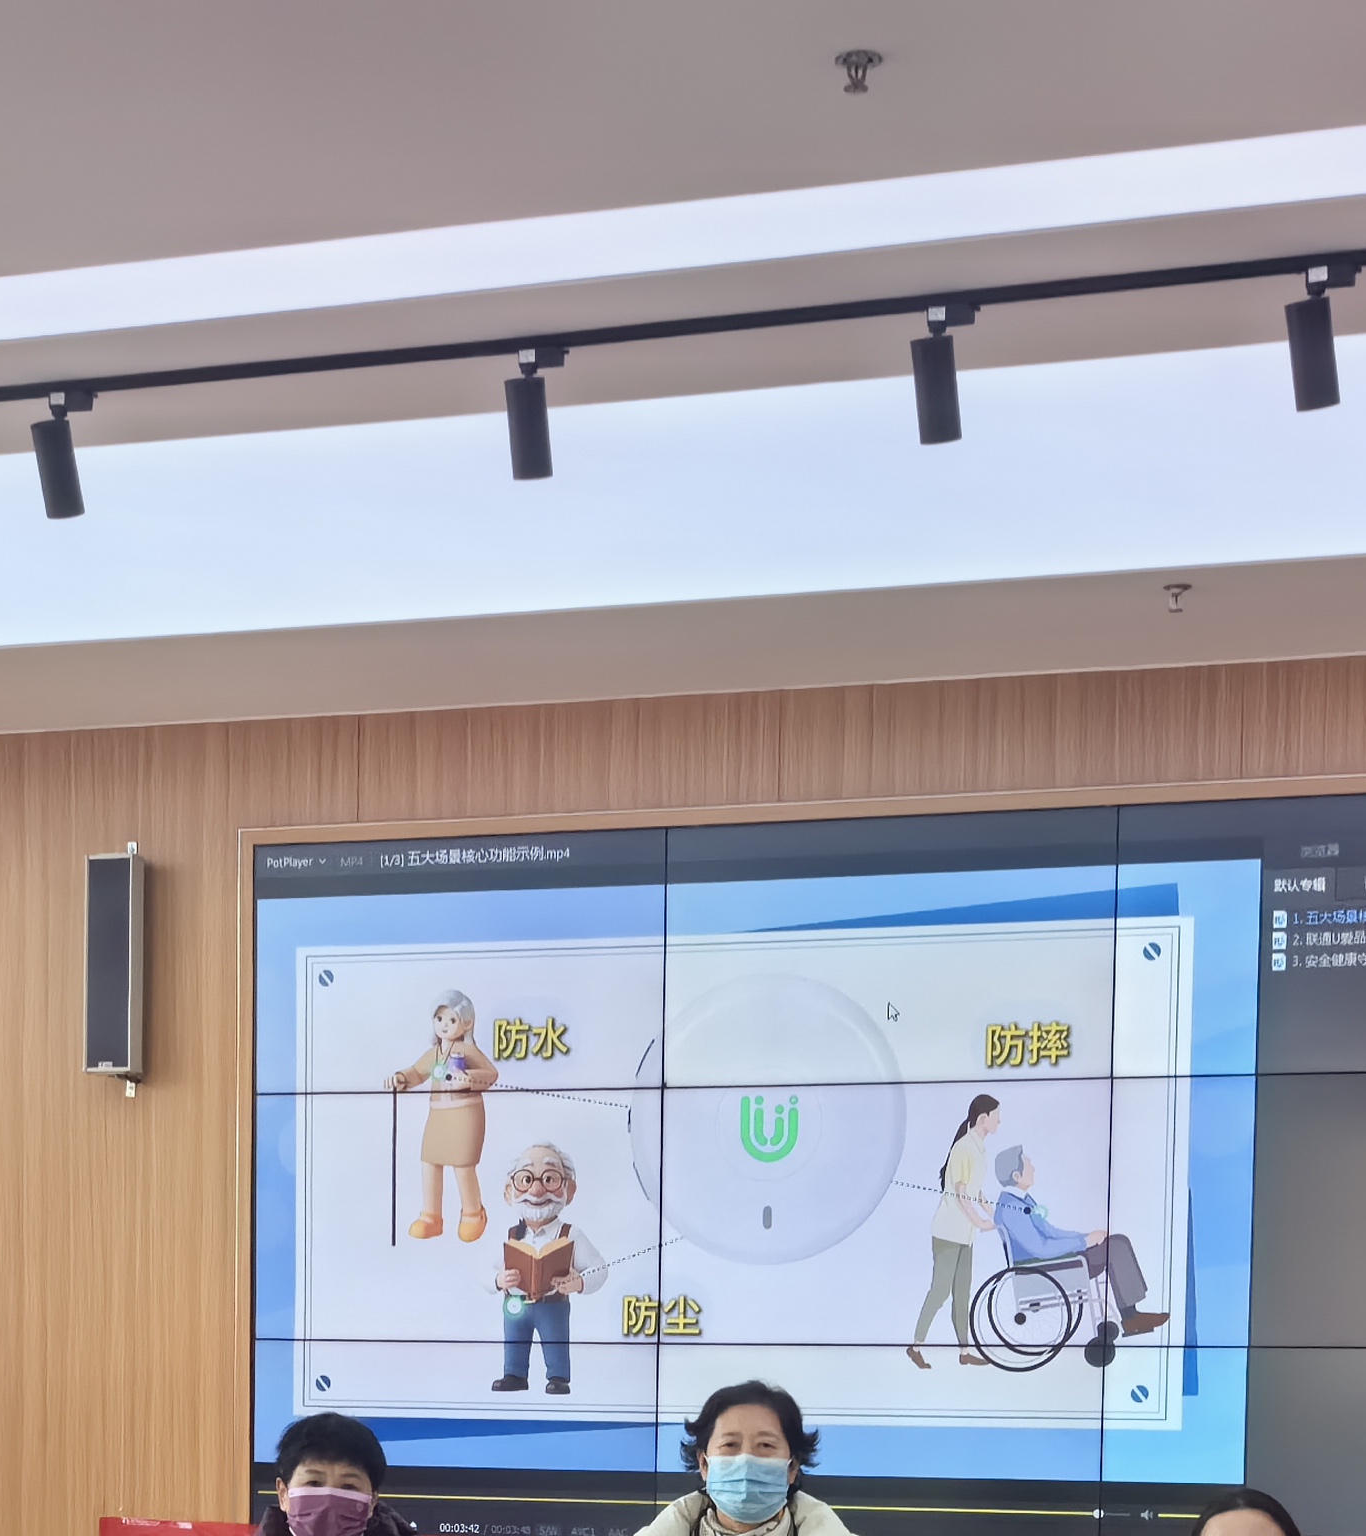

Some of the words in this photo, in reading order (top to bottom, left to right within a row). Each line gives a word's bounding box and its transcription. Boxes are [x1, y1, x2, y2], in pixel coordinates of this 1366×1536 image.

[266, 857, 313, 869] PotPlayer
[380, 854, 404, 868] [1/3]
[407, 845, 571, 867] 五大场景核心功能示例.mp4
[1274, 877, 1327, 893] 默认专辑
[1292, 934, 1304, 946] 2.
[1292, 955, 1304, 967] 3.
[492, 1016, 569, 1061] 防水
[985, 1022, 1071, 1068] 防摔
[621, 1295, 703, 1338] 防尘
[439, 1523, 480, 1534] 00:03:42
